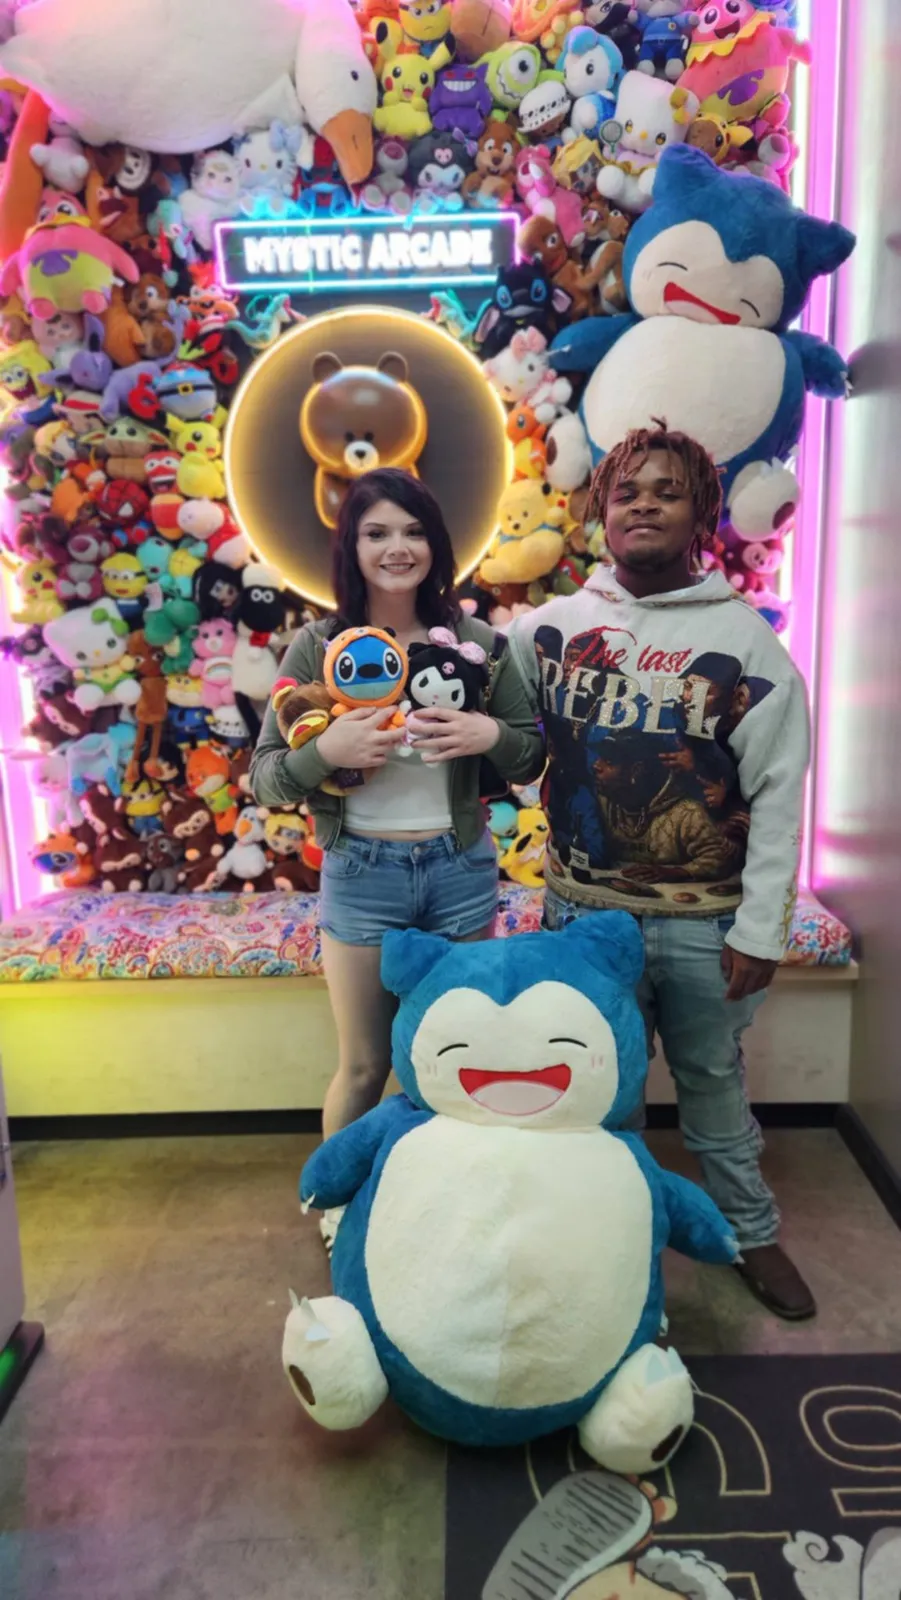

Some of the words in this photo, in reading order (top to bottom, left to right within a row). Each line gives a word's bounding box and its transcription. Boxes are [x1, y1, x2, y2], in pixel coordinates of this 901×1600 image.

[243, 234, 363, 274] MYSTIC
[367, 228, 493, 269] ARCADE
[565, 625, 638, 679] The
[636, 643, 694, 673] last
[541, 656, 722, 741] REBEL
